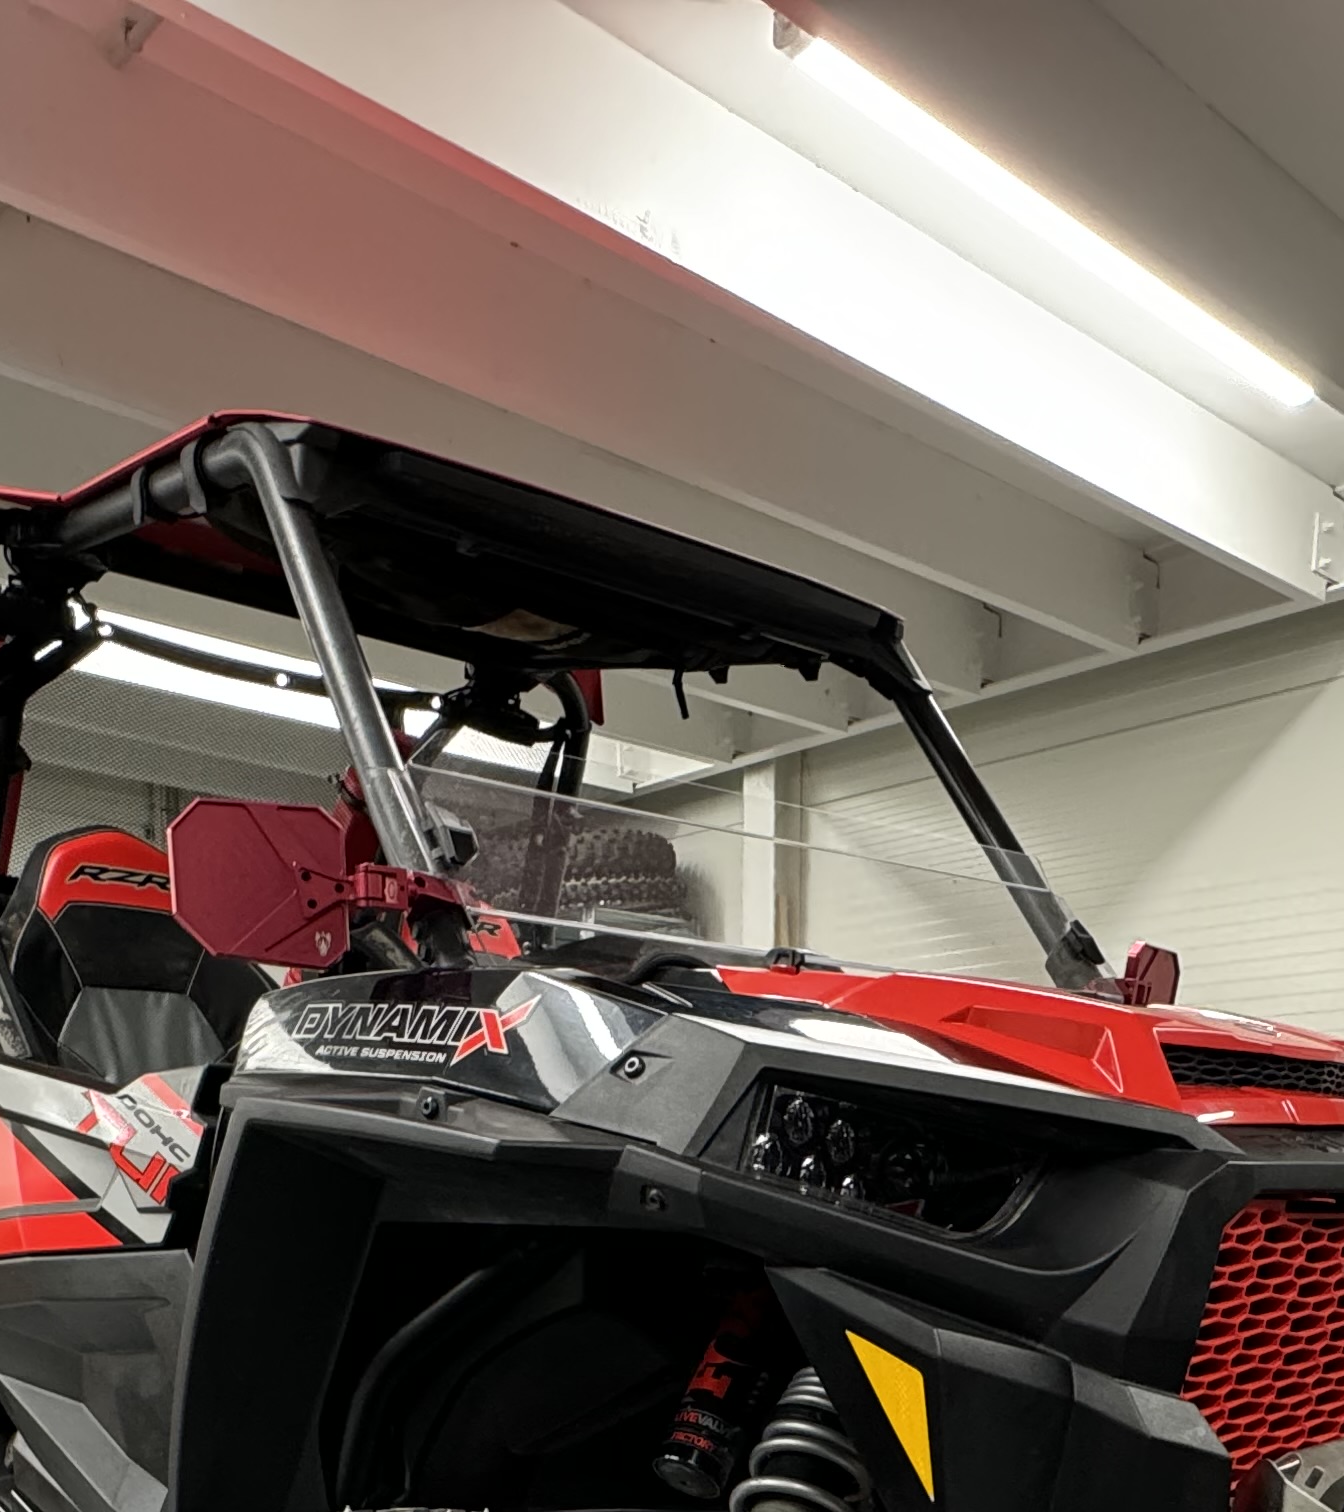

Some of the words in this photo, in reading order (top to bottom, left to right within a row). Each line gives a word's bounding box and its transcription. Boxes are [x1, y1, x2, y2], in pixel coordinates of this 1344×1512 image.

[64, 863, 171, 892] RZR
[293, 993, 543, 1067] DYNAMIX
[315, 1044, 359, 1058] ACTIVE
[360, 1047, 446, 1064] SUSPENSION
[117, 1093, 191, 1163] DOHC
